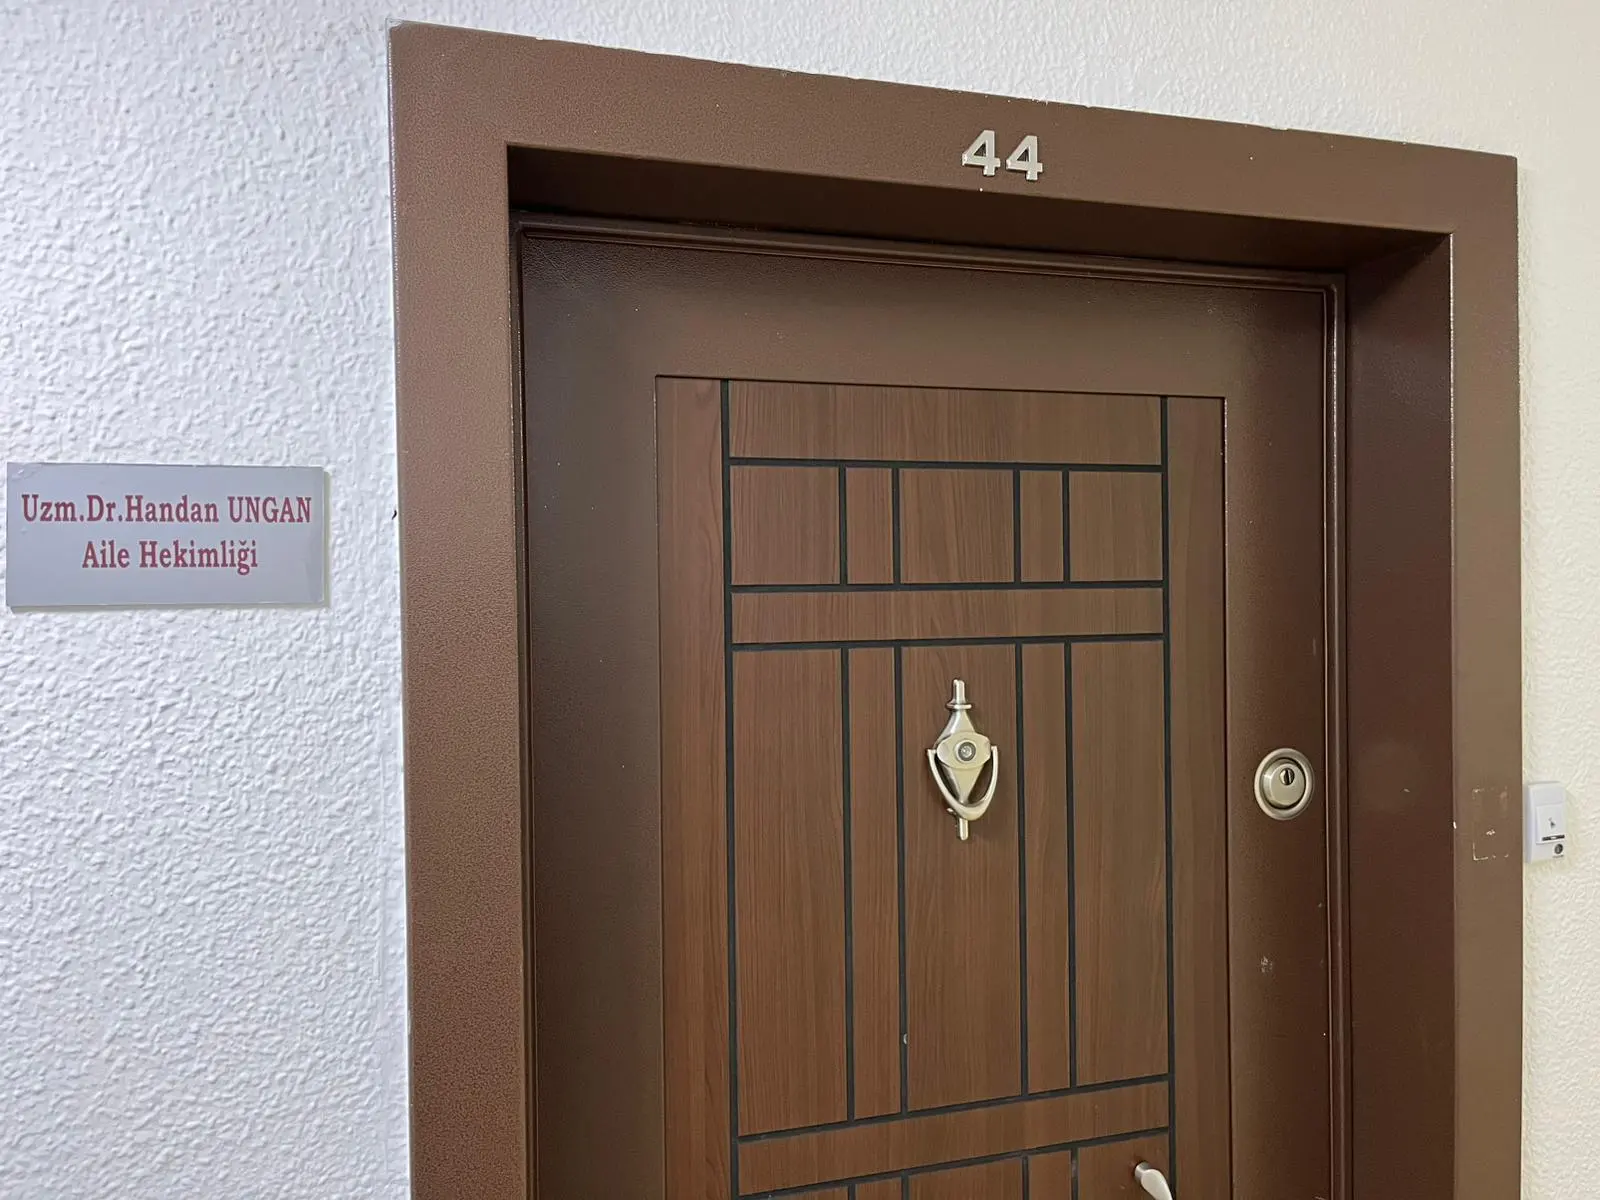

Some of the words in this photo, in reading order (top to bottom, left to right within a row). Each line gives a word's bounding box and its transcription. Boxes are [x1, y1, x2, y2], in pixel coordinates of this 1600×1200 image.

[961, 129, 1043, 181] 44
[21, 494, 220, 523] Uzm.Dr.Handan
[227, 496, 313, 523] UNGAN
[82, 540, 130, 569] Aile
[139, 540, 259, 576] Hekimliği
